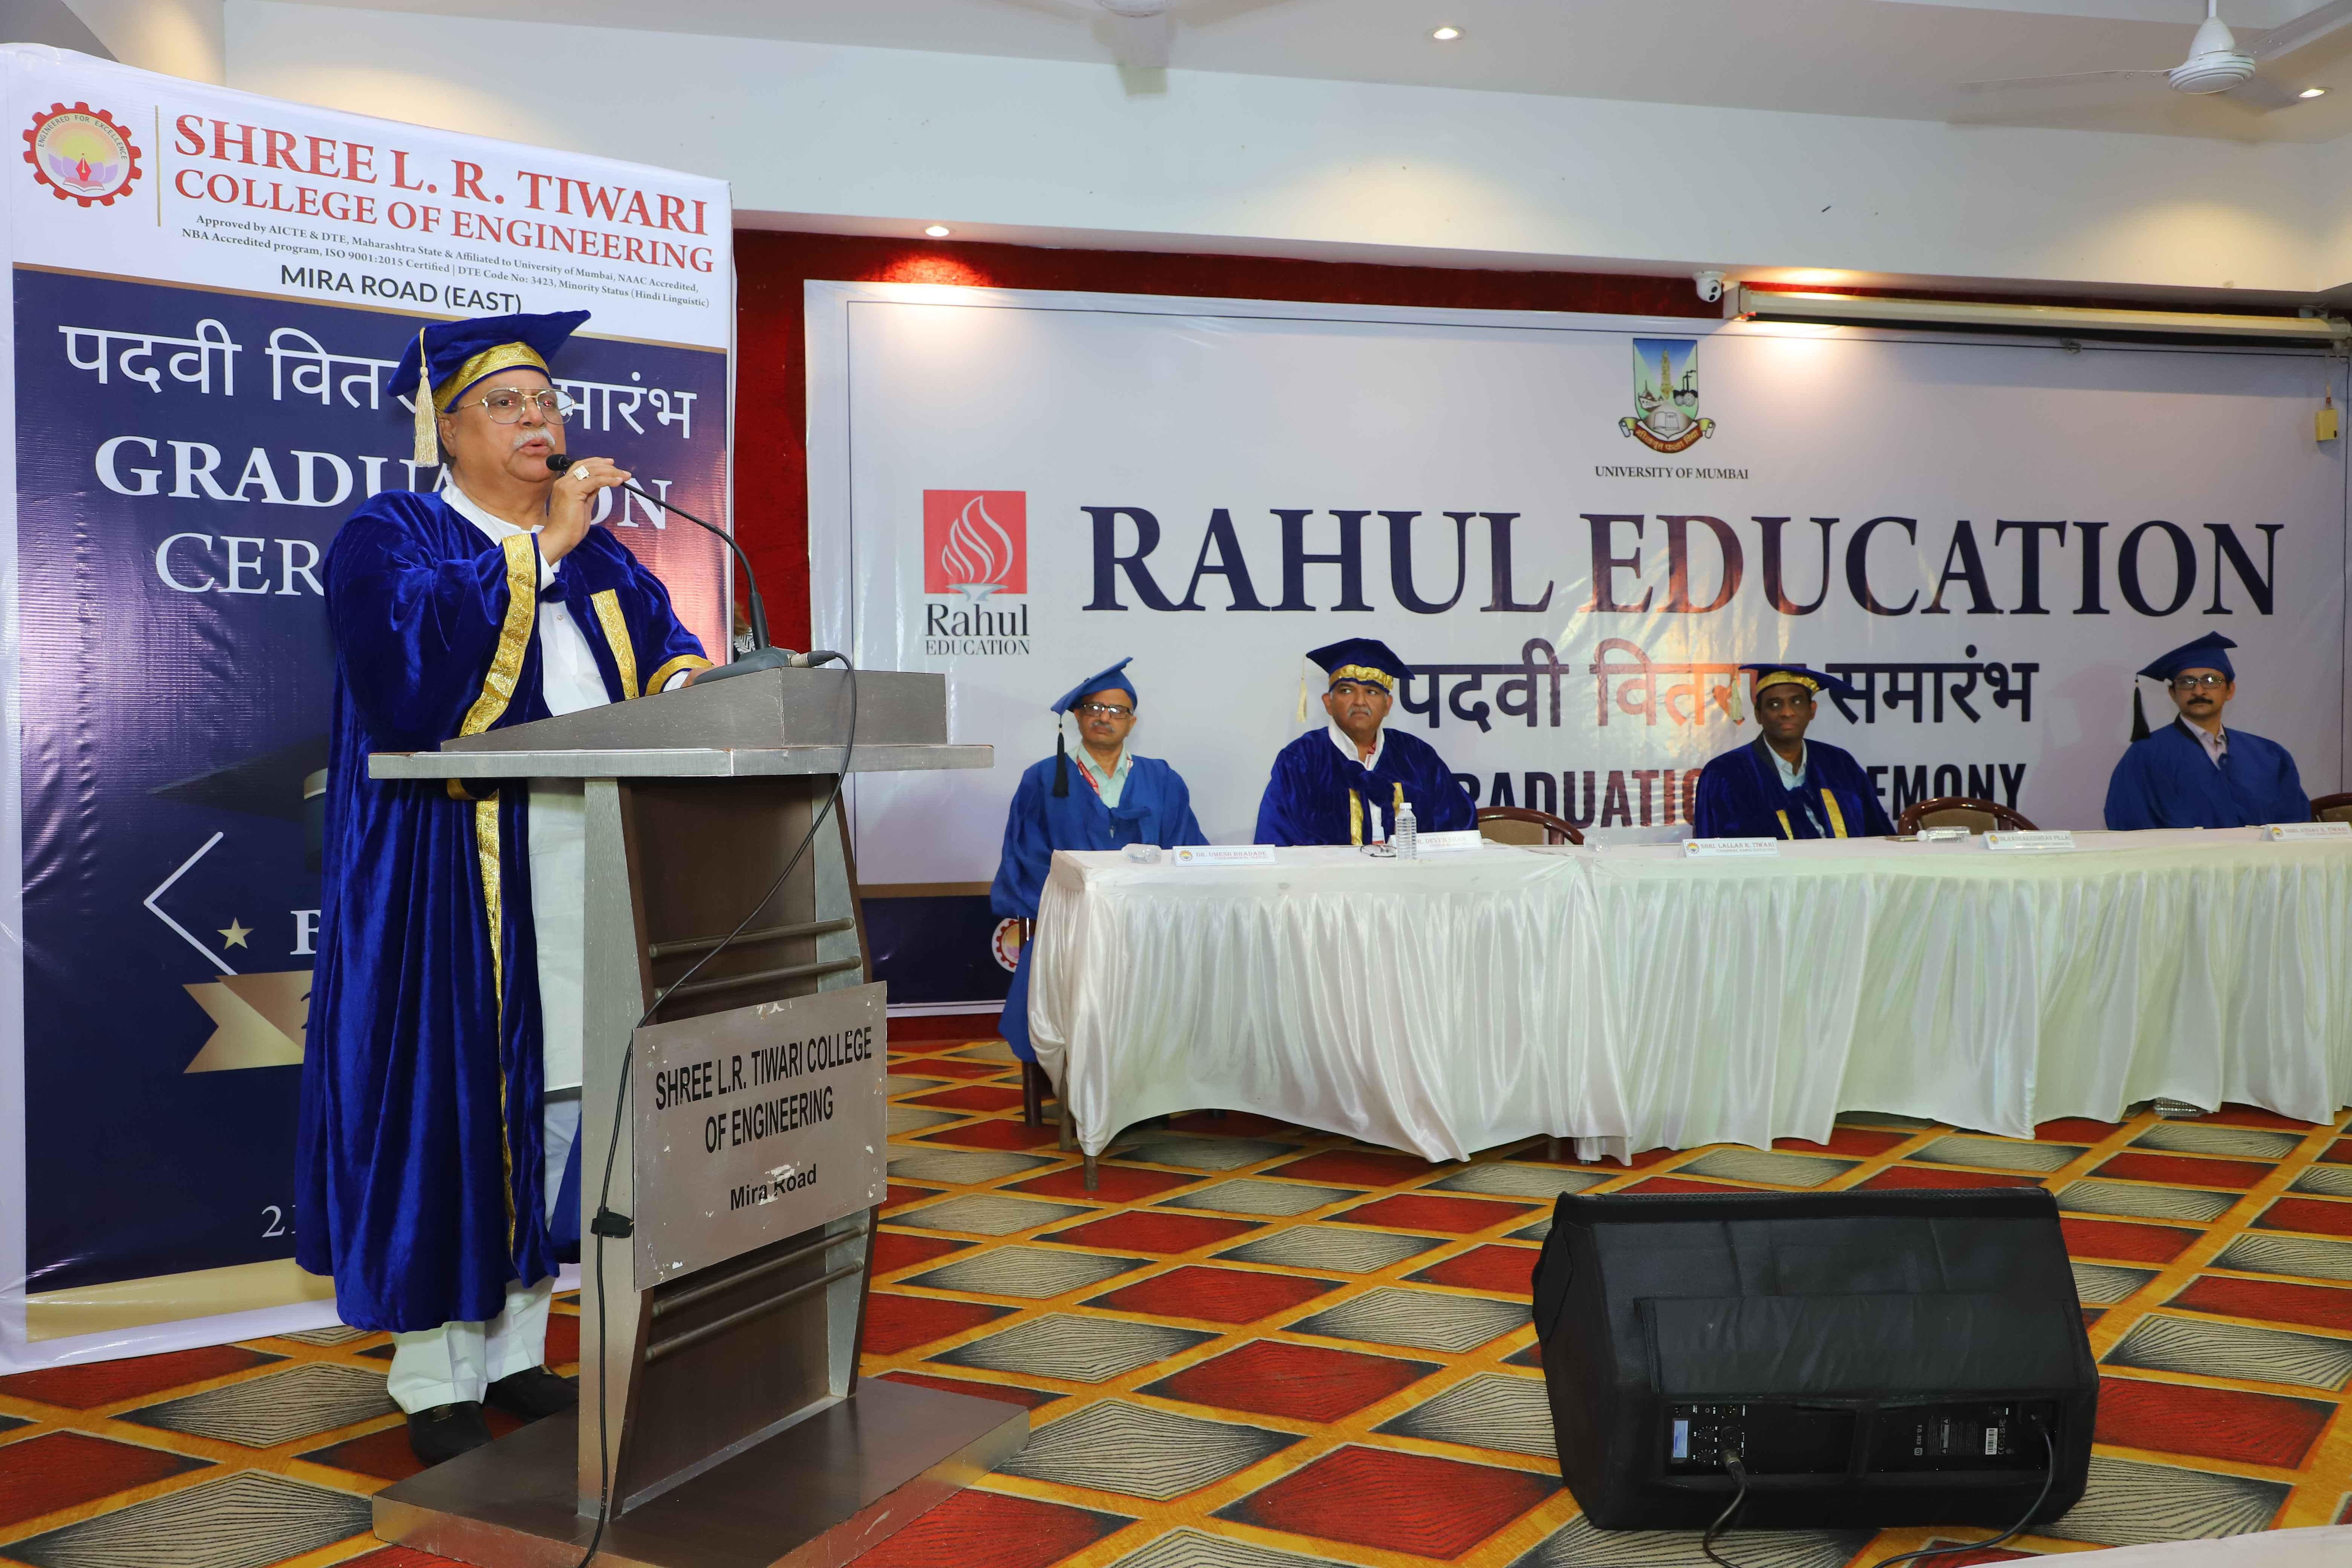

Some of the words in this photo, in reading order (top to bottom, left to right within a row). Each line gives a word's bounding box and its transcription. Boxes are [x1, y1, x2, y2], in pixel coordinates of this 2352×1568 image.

[38, 115, 70, 147] ENGINEERED
[74, 115, 90, 123] FOR
[95, 120, 128, 160] EXCELLENCE
[175, 114, 377, 184] SHREE
[390, 150, 437, 193] L.
[451, 159, 504, 204] R.
[518, 170, 709, 236] TIWARI
[175, 169, 377, 224] COLLEGE
[388, 202, 441, 232] OF
[451, 210, 714, 272] ENGINEERING
[196, 215, 250, 231] Approved
[254, 220, 266, 234] by
[269, 225, 307, 239] AICTE
[310, 231, 319, 240] &
[322, 233, 349, 245] DTE,
[352, 237, 415, 253] Maharashtra
[418, 246, 442, 257] State
[445, 250, 453, 258] &
[455, 251, 499, 265] Affiliated
[502, 257, 511, 266] to
[514, 259, 562, 275] University
[576, 269, 616, 282] Mumbai,
[618, 274, 647, 285] NAAC
[649, 278, 699, 293] Accredited,
[182, 228, 209, 240] NBA
[212, 233, 271, 249] Accredited
[274, 242, 322, 257] program,
[325, 248, 345, 259] ISO
[348, 251, 403, 267] 9001:2015
[406, 259, 450, 273] Certified
[458, 266, 481, 276] DTE
[484, 270, 508, 281] Code
[511, 274, 528, 283] No:
[531, 276, 556, 288] 3423,
[559, 280, 600, 295] Minority
[602, 285, 629, 297] Status
[631, 288, 660, 301] (Hindi
[663, 294, 709, 308] Linguistic)
[282, 265, 354, 293] MIRA
[362, 276, 438, 303] ROAD
[445, 285, 521, 314] (EAST)
[59, 319, 242, 397] पदवी
[1596, 466, 1673, 478] UNIVERSITY
[1676, 468, 1693, 478] OF
[1696, 468, 1749, 479] MUMBAI
[1081, 506, 1554, 614] RAHUL
[1580, 514, 2285, 618] EDUCATION
[925, 603, 1030, 637] Rahul
[925, 640, 1030, 655] EDUCATION
[1400, 638, 1569, 733] पदवी
[656, 1061, 712, 1110] SHREE
[718, 1055, 747, 1095] L.R.
[752, 1041, 802, 1086] TIWARI
[807, 1027, 871, 1072] COLLEGE
[706, 1113, 726, 1153] OF
[732, 1086, 833, 1146] ENGINEERING
[730, 1185, 767, 1211] Mira
[774, 1164, 817, 1196] Road
